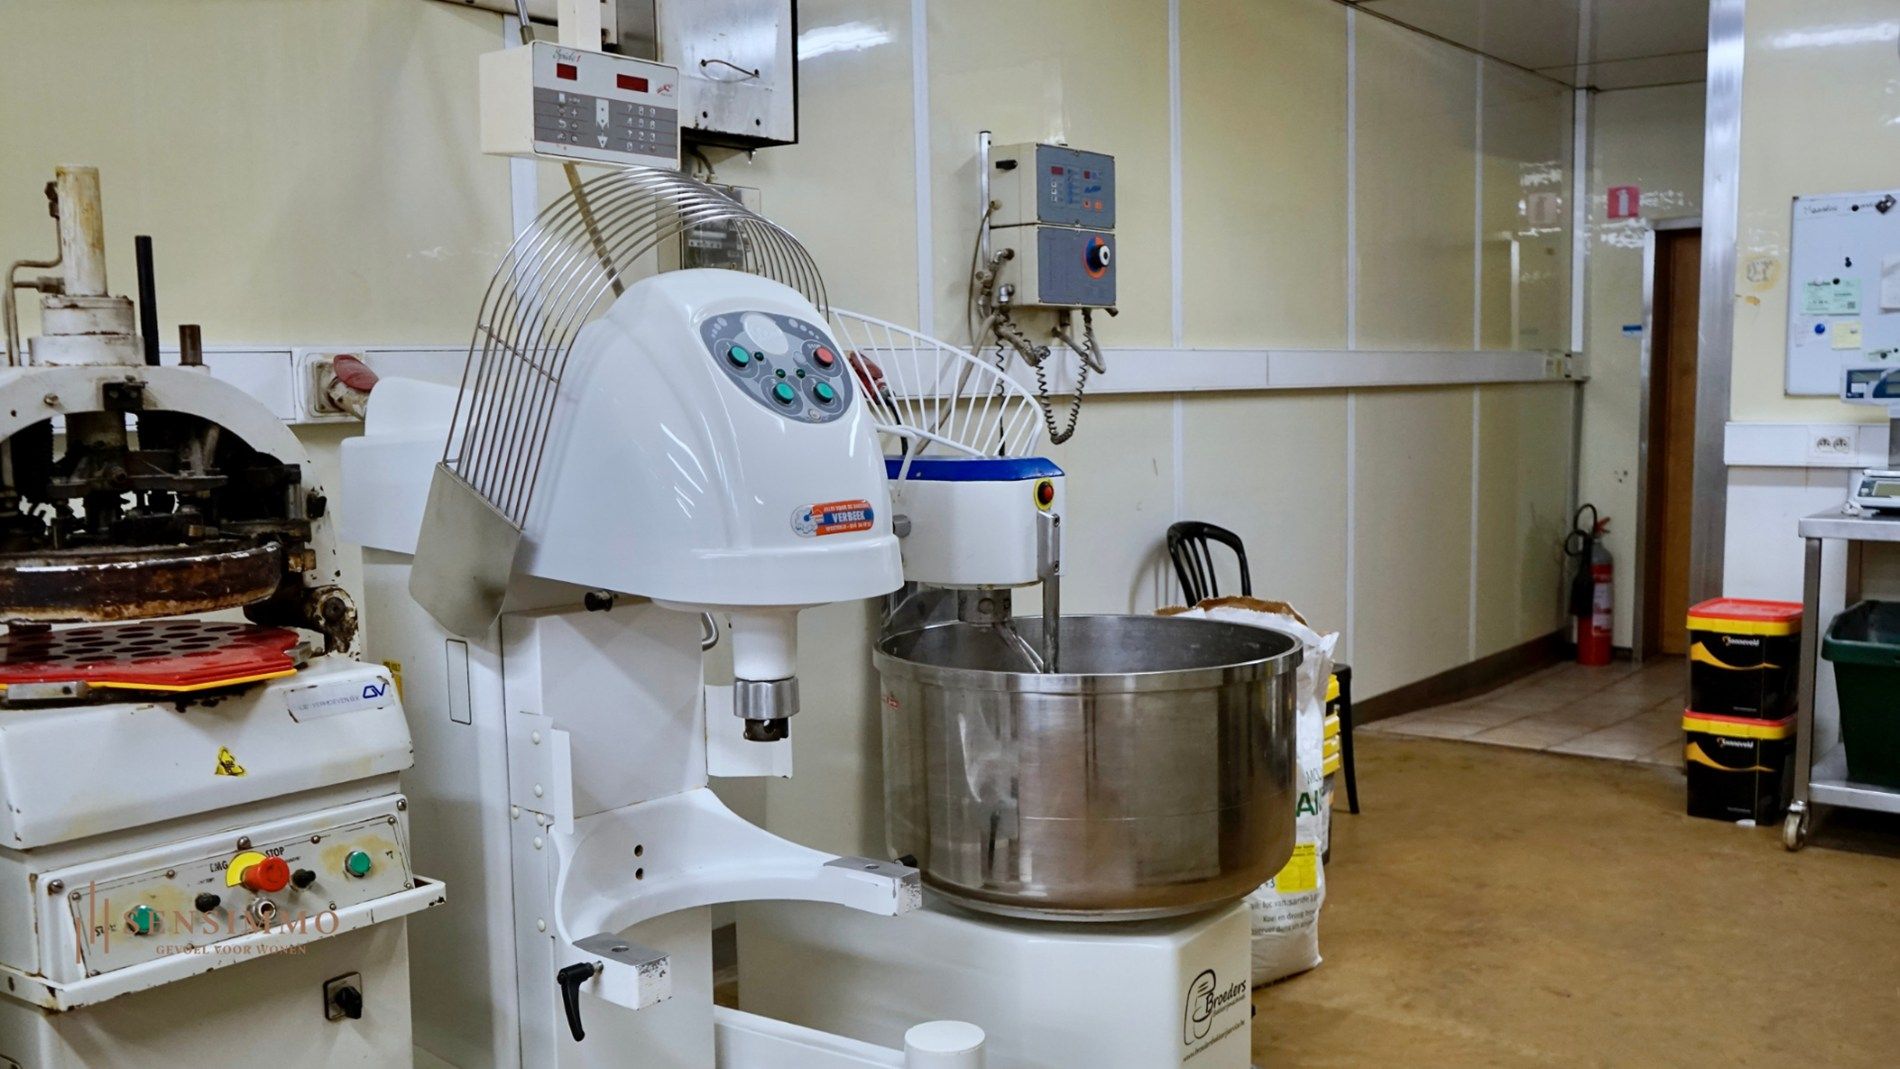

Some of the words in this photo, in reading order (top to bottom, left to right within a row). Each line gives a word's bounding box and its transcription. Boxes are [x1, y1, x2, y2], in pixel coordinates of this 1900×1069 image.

[831, 510, 866, 523] VERBEEK
[265, 846, 285, 858] STOP
[1205, 979, 1247, 1014] Broeders
